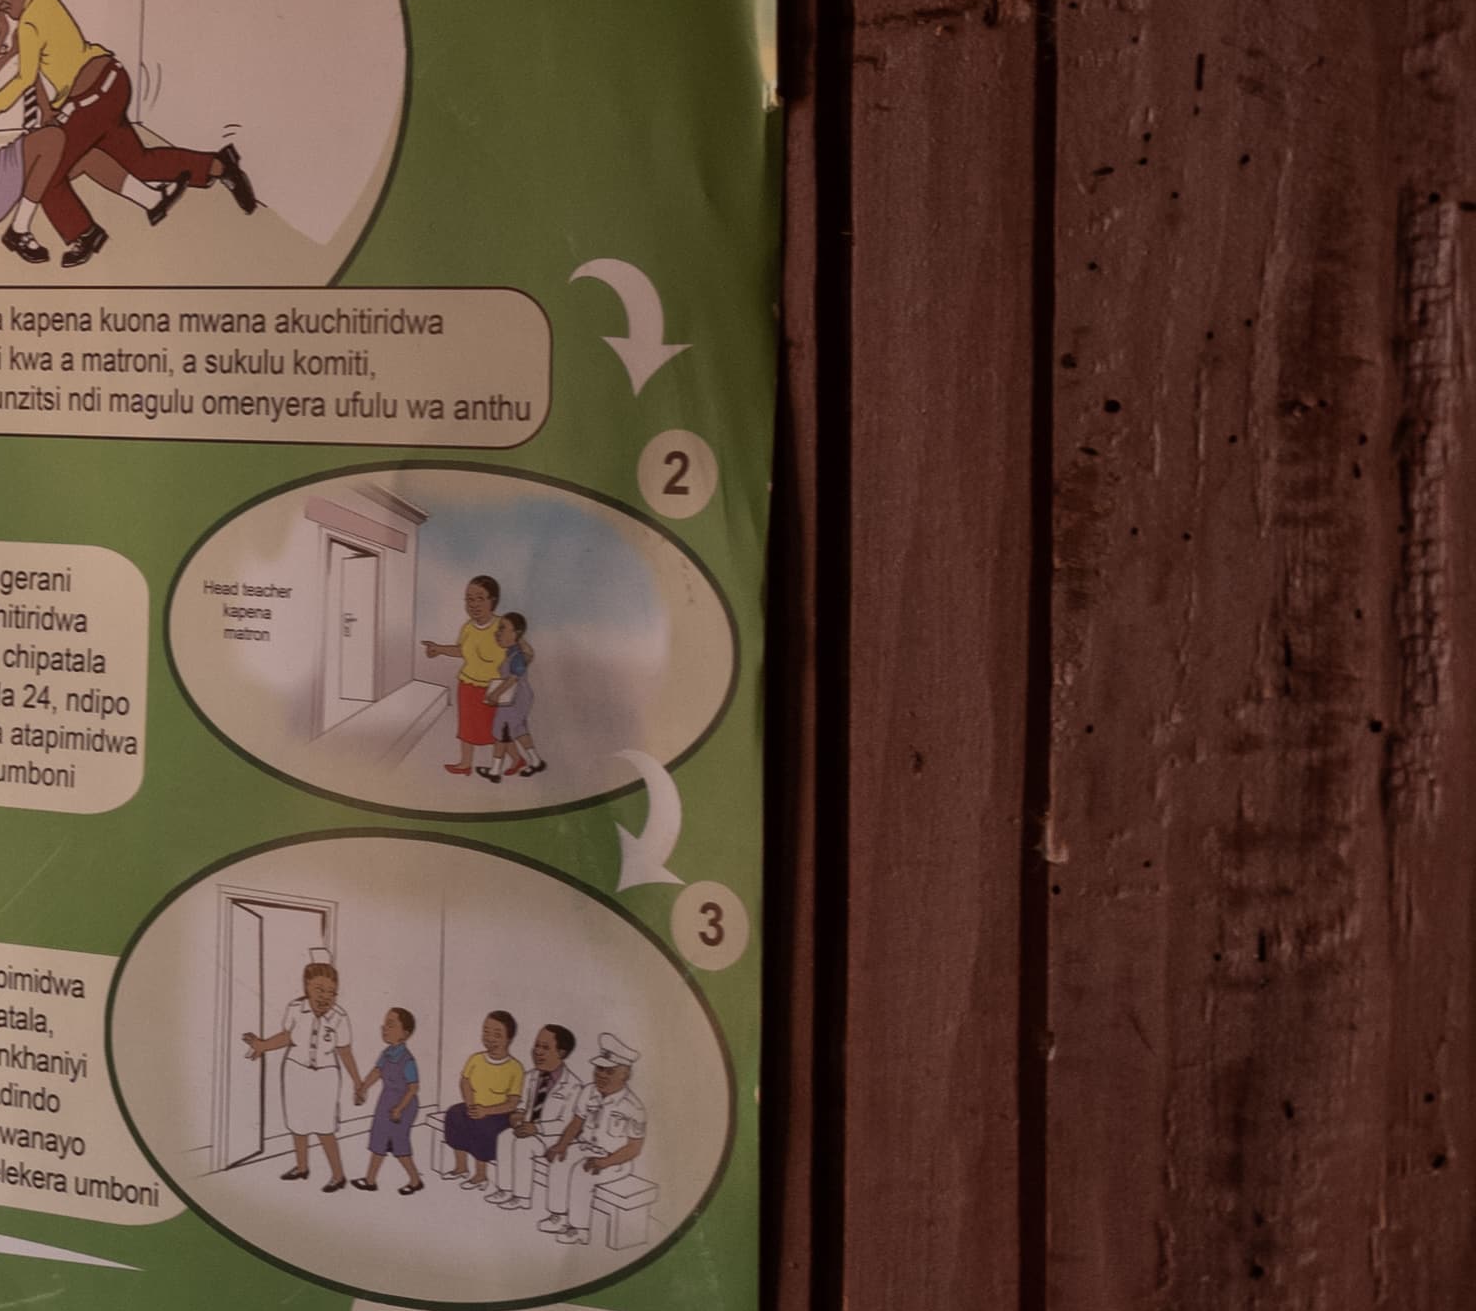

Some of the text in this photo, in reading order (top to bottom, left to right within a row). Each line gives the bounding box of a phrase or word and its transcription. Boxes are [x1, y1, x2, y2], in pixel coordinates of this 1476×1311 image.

[11, 306, 92, 337] kapena
[101, 307, 170, 332] kuona
[179, 313, 266, 333] mwana
[274, 308, 443, 335] akuchitiridwa
[10, 346, 53, 371] kwa
[61, 352, 74, 371] a
[82, 348, 173, 376] matroni,
[182, 354, 197, 373] a
[205, 348, 284, 375] sukulu
[293, 349, 375, 380] komiti,
[69, 386, 101, 412] ndi
[109, 389, 193, 420] magulu
[202, 395, 325, 423] omenyera
[335, 391, 397, 419] ufulu
[406, 399, 444, 420] wa
[454, 394, 530, 421] anthu
[661, 450, 690, 495] 2
[3, 644, 105, 675] chipatala
[22, 684, 57, 714] 24,
[66, 688, 130, 720] ndipo
[10, 724, 137, 755] atapimidwa
[698, 901, 725, 947] 3
[75, 1176, 159, 1206] umboni
